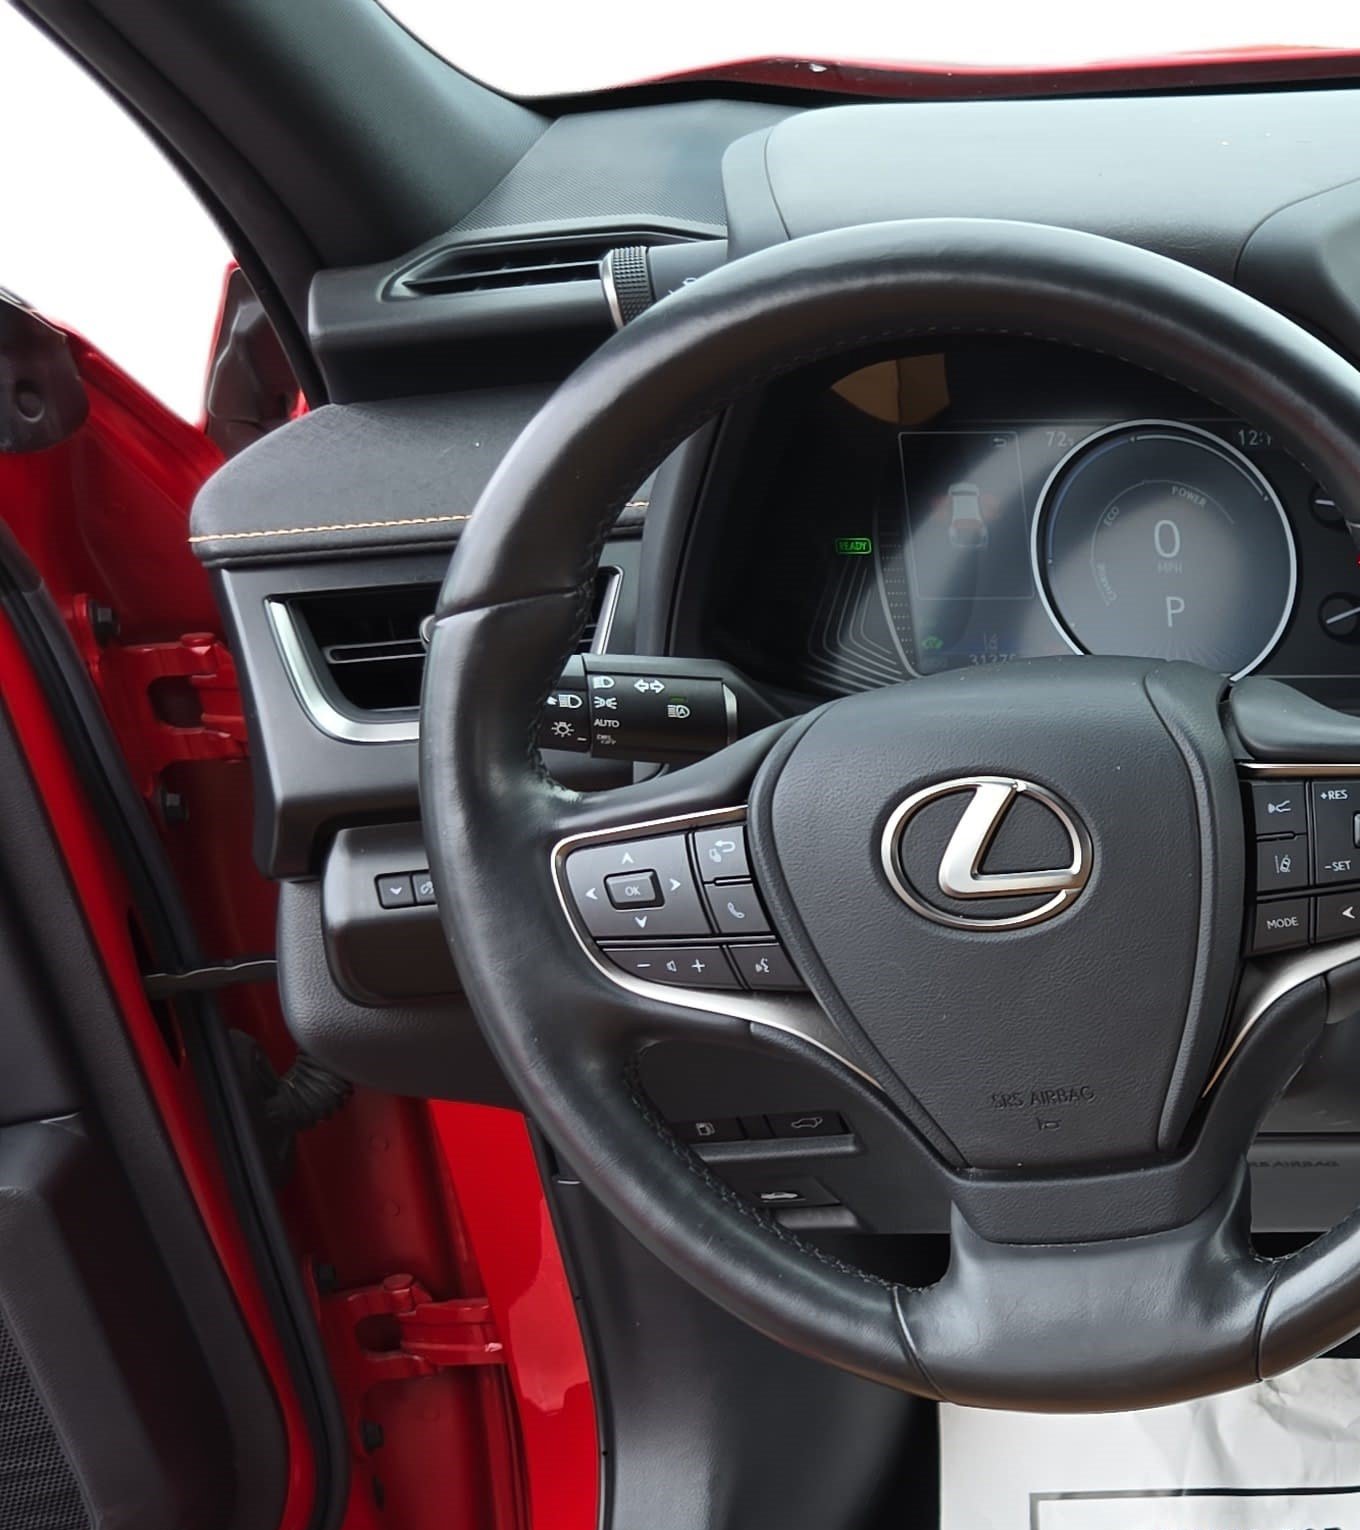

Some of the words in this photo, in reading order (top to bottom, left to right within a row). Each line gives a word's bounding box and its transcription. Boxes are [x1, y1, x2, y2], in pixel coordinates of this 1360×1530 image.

[1171, 485, 1208, 509] POWER
[1154, 519, 1181, 559] 0
[1165, 595, 1186, 628] P
[594, 718, 621, 728] AUTO
[624, 886, 641, 897] OK
[1266, 916, 1300, 930] MODE
